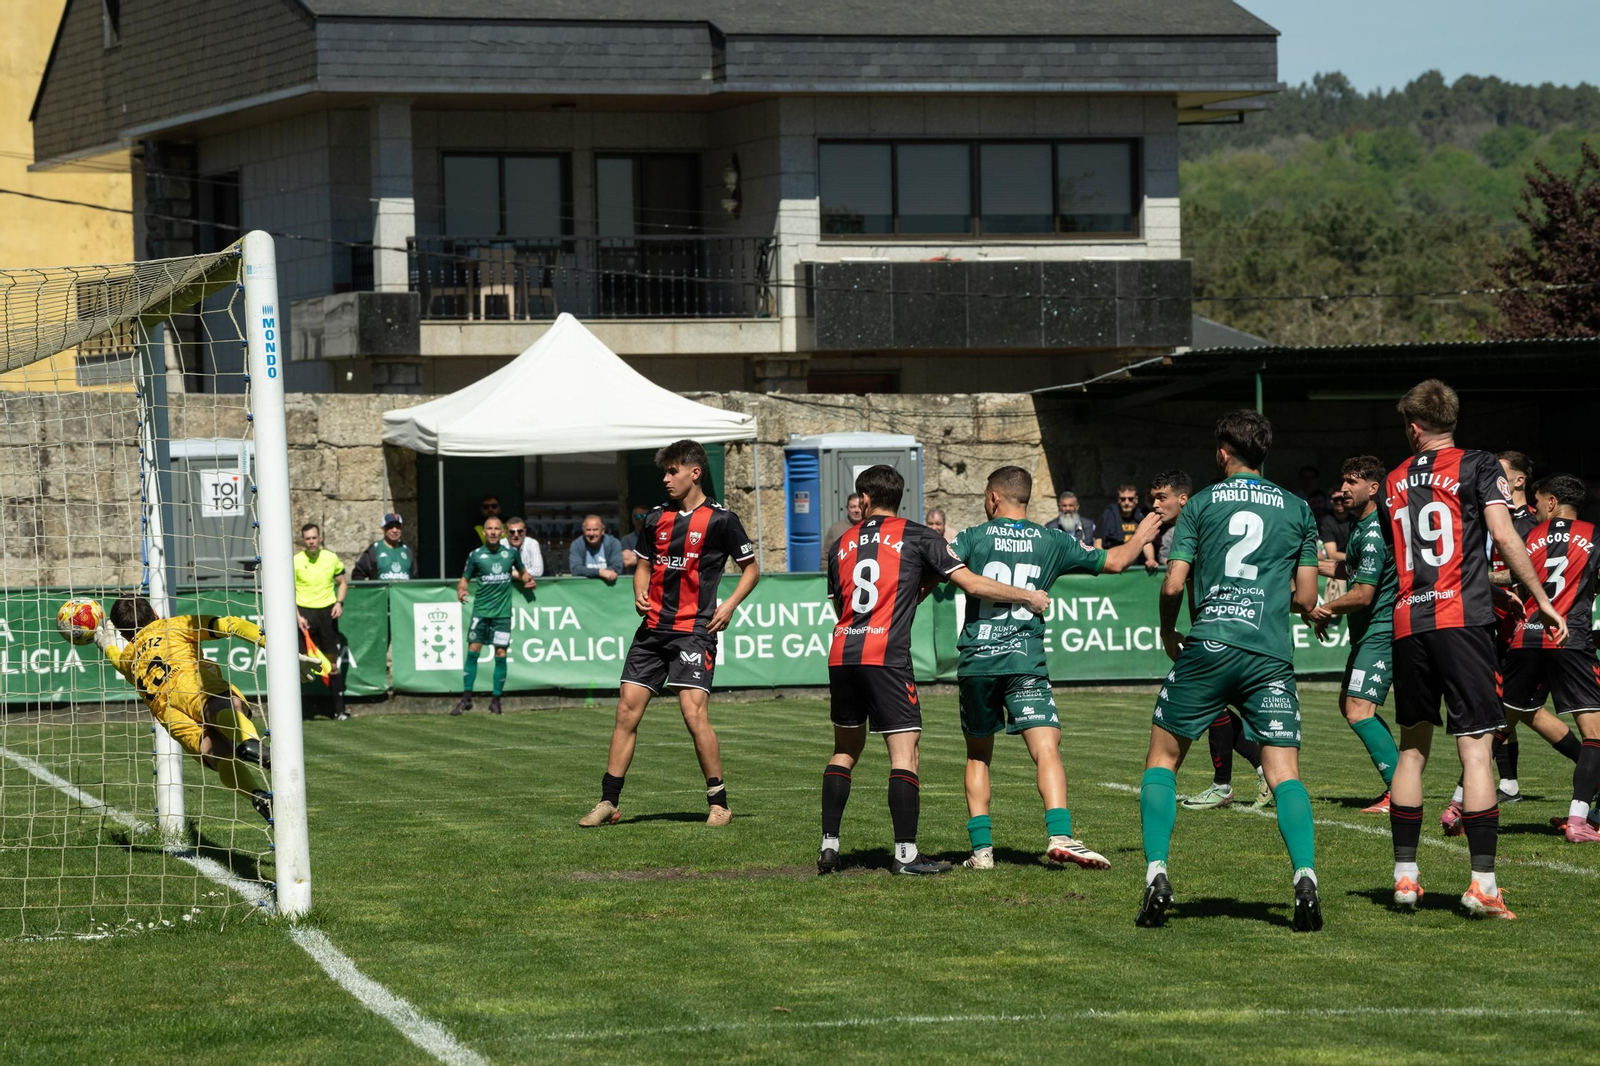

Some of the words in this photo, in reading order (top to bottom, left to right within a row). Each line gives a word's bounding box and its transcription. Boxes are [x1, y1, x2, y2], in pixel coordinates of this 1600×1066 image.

[262, 318, 277, 378] MONDO
[212, 482, 238, 496] TOI
[1396, 472, 1461, 496] MUTILVA
[212, 497, 238, 510] TOI
[1211, 489, 1248, 504] PABLO
[1251, 490, 1285, 510] MOYA
[837, 532, 904, 561] ZABALA
[994, 538, 1033, 552] BASTIDA
[1224, 510, 1264, 580] 2
[1393, 501, 1455, 572] 19
[851, 558, 881, 614] 8
[979, 561, 1041, 620] 25
[1544, 555, 1570, 603] 3
[1043, 597, 1118, 622] UNTA
[1406, 589, 1455, 606] SteelPhalt
[471, 616, 480, 630] 7
[511, 606, 582, 631] NTA
[735, 602, 840, 628] XUNTA
[843, 625, 885, 635] SteelPhalt
[1061, 626, 1184, 653] GALICI
[1292, 624, 1310, 648] E
[522, 636, 625, 663] GALICI
[735, 634, 774, 659] DE
[1, 648, 86, 675] LICIA
